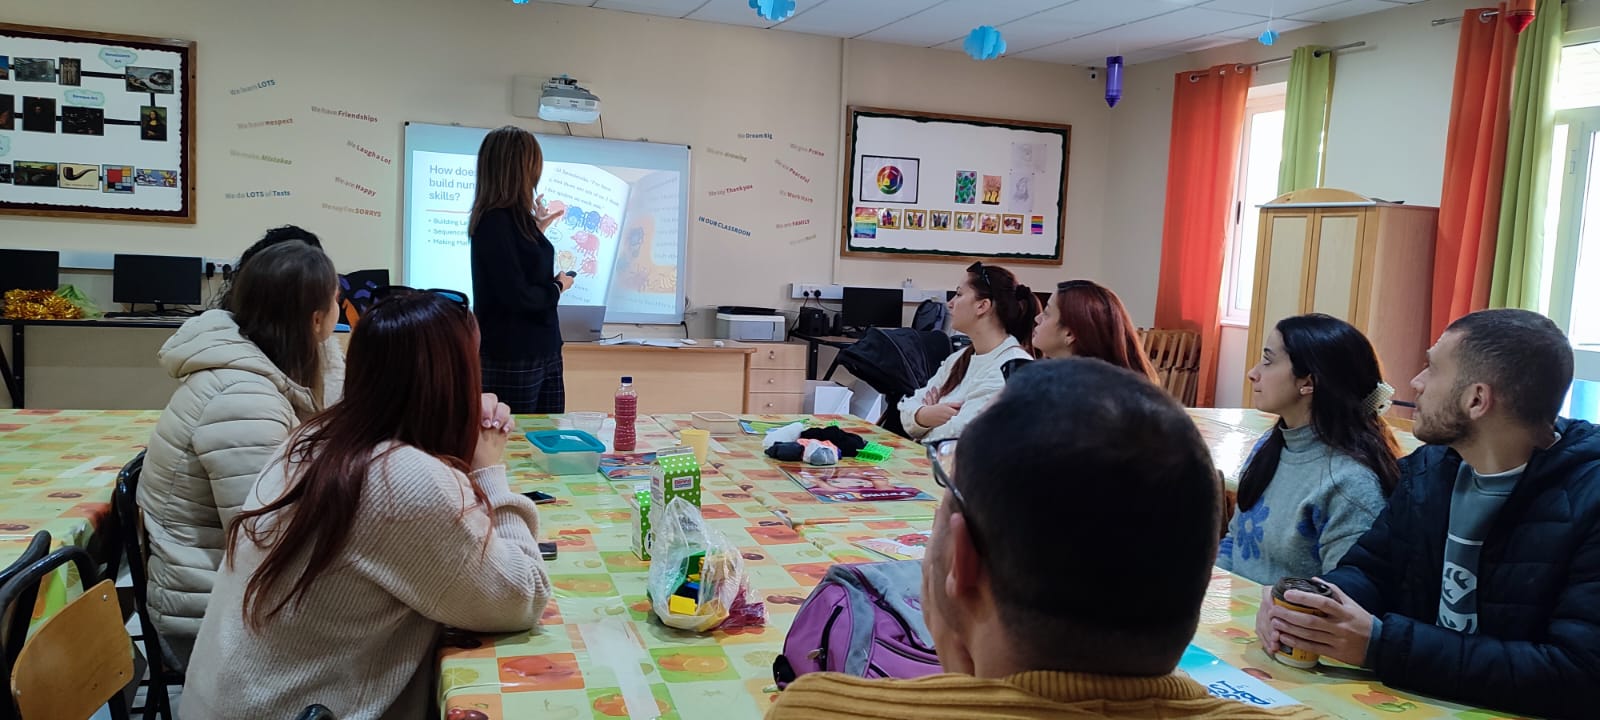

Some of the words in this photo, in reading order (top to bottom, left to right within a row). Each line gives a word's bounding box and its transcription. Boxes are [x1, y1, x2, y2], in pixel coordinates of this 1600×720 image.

[257, 79, 276, 89] LOTS
[338, 110, 378, 123] Friendships
[356, 145, 376, 158] Laugh
[380, 156, 391, 165] Lot
[429, 165, 453, 175] How
[789, 168, 810, 184] Peaceful
[429, 179, 454, 189] build
[355, 183, 377, 197] Happy
[429, 191, 461, 201] skills?
[433, 218, 458, 226] Building
[792, 219, 810, 227] FAMILY
[705, 218, 717, 226] OUR
[718, 222, 751, 237] CLASSROOM
[433, 239, 455, 247] Making
